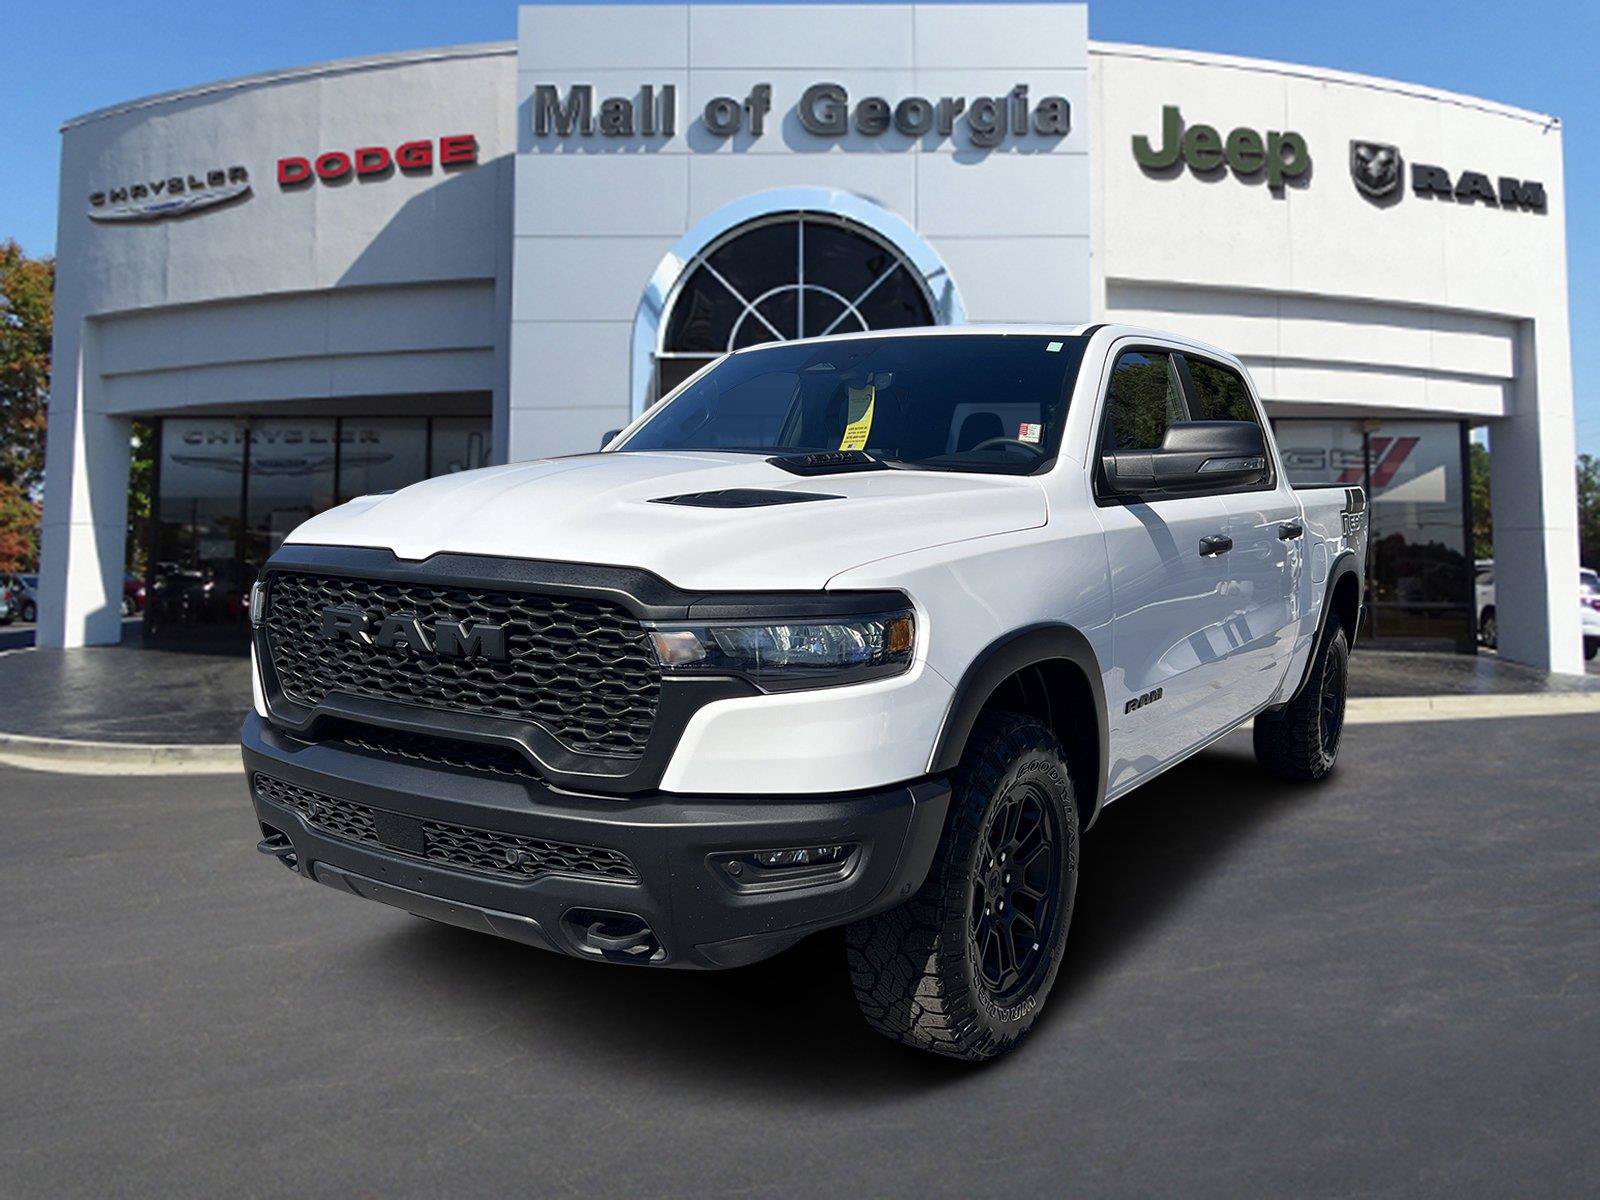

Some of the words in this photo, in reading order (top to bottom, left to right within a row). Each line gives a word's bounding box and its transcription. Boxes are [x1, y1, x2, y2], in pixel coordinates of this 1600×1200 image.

[533, 83, 676, 136] Mall
[704, 82, 772, 136] of
[800, 82, 1072, 148] Georgia
[277, 134, 477, 189] DODGE
[1132, 104, 1309, 189] Jeep
[89, 165, 249, 207] CHRYSLER
[1411, 162, 1546, 213] RAM
[321, 603, 507, 662] RAM
[1125, 687, 1163, 715] RAM
